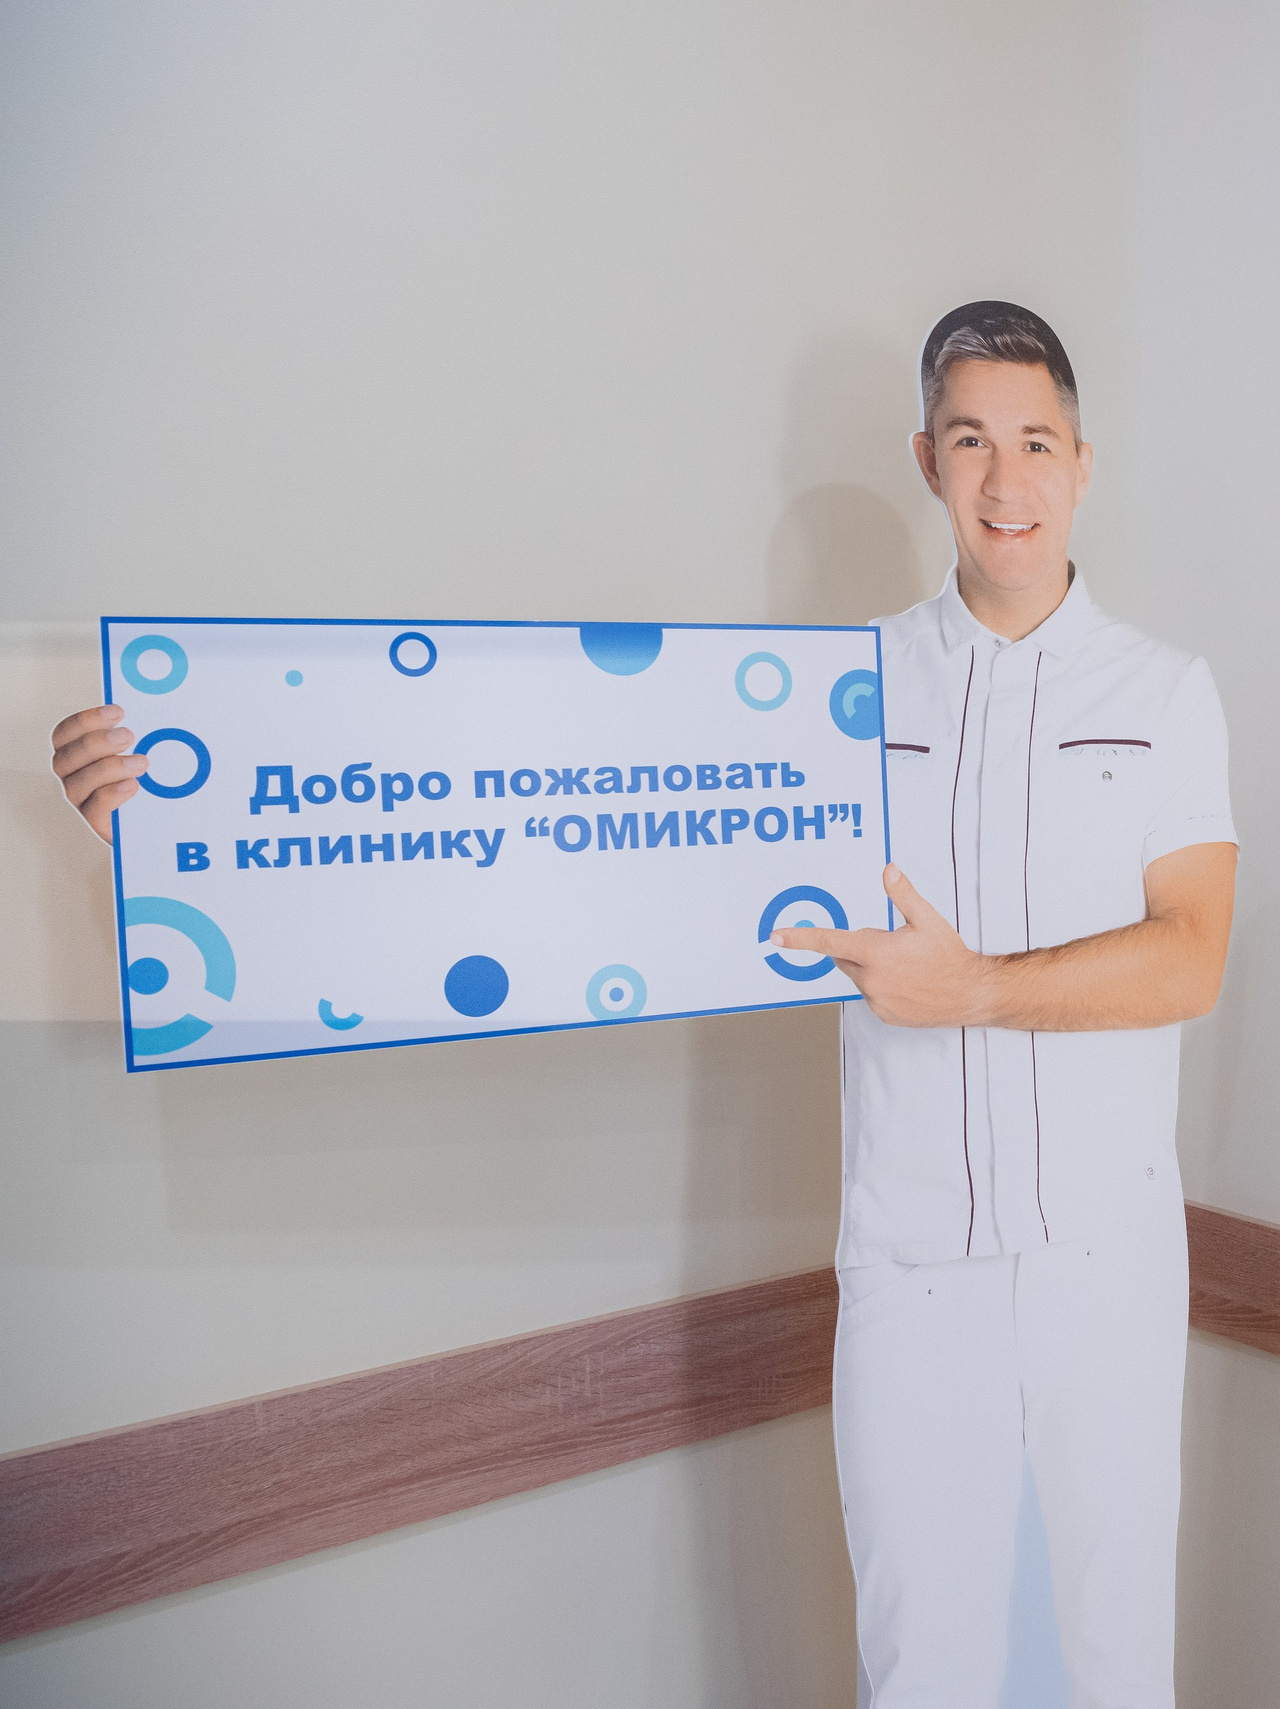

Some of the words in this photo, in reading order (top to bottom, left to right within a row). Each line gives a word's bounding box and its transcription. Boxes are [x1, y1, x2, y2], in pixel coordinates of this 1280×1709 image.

[248, 761, 453, 817] Добро
[473, 761, 807, 800] пожаловать
[174, 840, 212, 873] в
[234, 827, 507, 871] клинику
